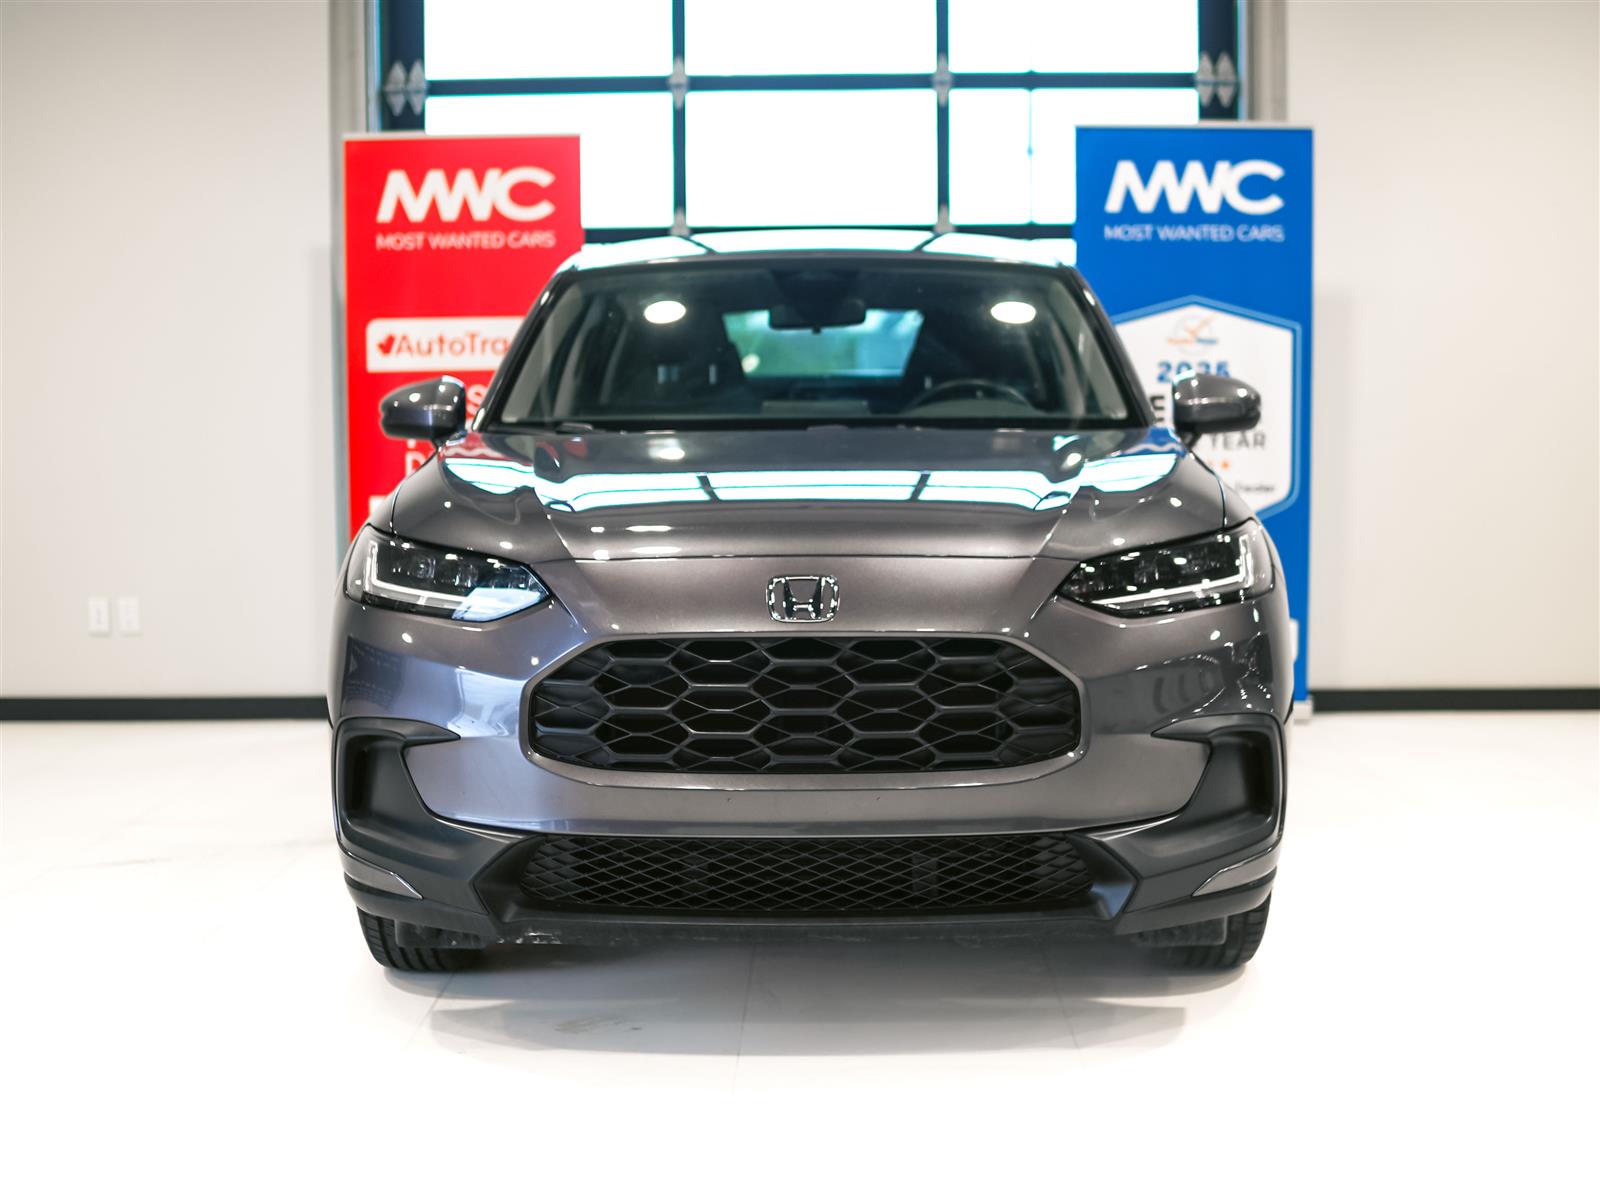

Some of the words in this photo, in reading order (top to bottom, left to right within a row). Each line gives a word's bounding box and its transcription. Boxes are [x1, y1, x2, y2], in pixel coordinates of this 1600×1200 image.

[376, 166, 556, 223] MWC
[1104, 160, 1285, 215] MWC
[376, 232, 425, 250] MOST
[428, 231, 504, 249] WANTED
[507, 230, 556, 249] CARS
[1104, 224, 1153, 241] MOST
[1157, 224, 1234, 242] WANTED
[1236, 224, 1285, 242] CARS
[396, 332, 509, 356] AutoTra
